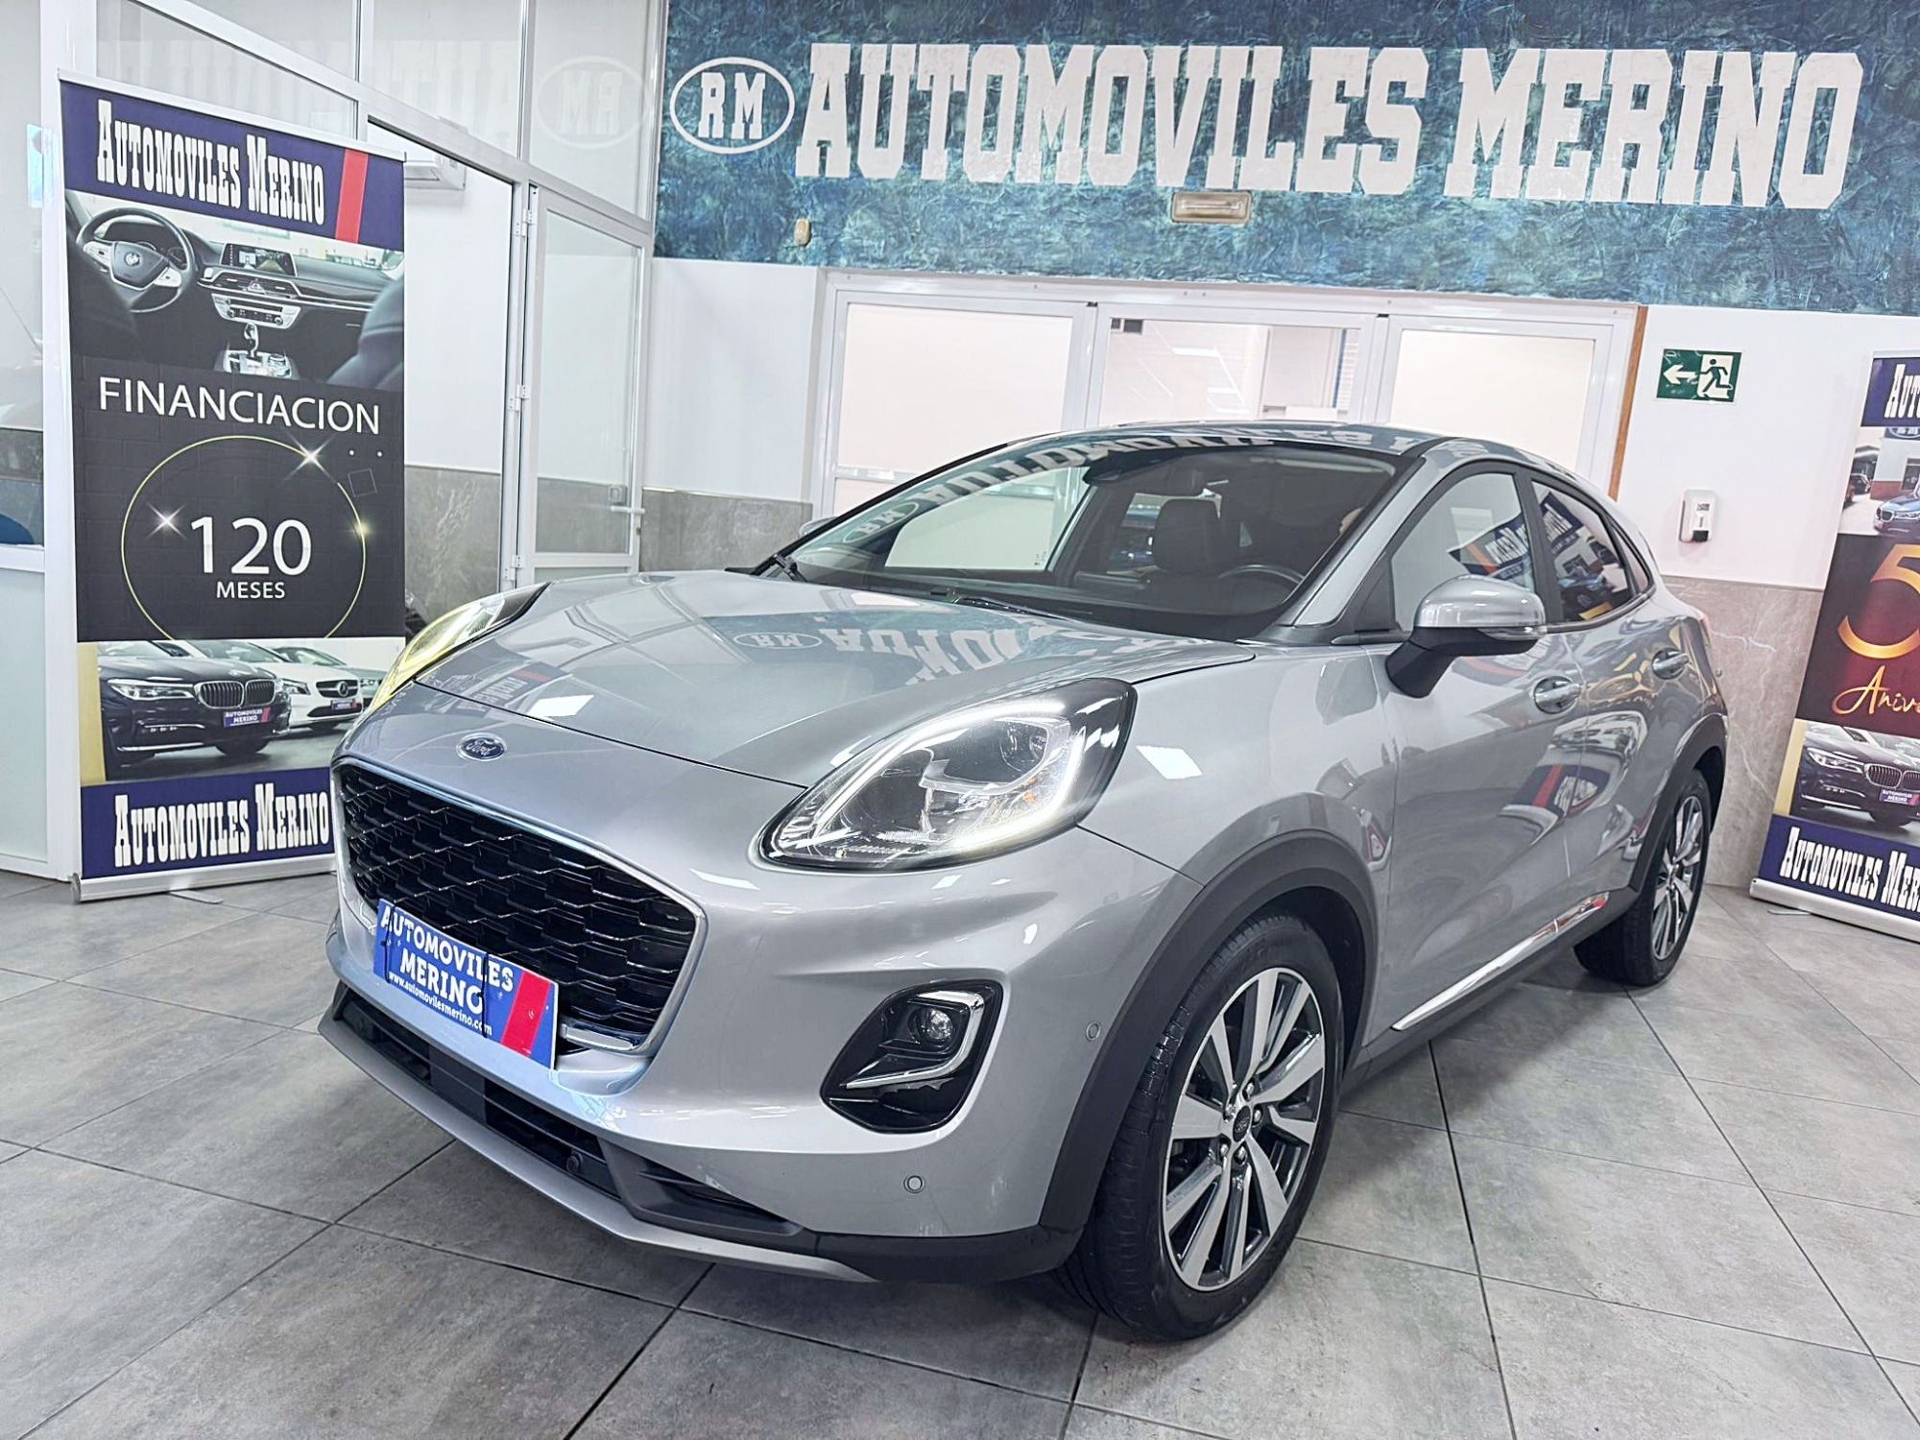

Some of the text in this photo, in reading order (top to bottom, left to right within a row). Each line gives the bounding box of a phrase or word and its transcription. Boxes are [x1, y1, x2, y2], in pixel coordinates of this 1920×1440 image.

[698, 71, 766, 140] RM
[795, 42, 1864, 210] AUTOMOVILES MERINO
[97, 98, 325, 226] AUTOMOVILES MERINO
[99, 376, 380, 436] FINANCIACION
[1884, 363, 1920, 419] AUT
[190, 515, 313, 577] 120
[216, 580, 286, 600] MESES
[115, 783, 330, 867] AUTOMOVILES MERINO
[1780, 826, 1883, 901] AUTOMOVILES
[380, 905, 514, 993] AUTOMOVILES
[400, 947, 484, 1015] MERINO
